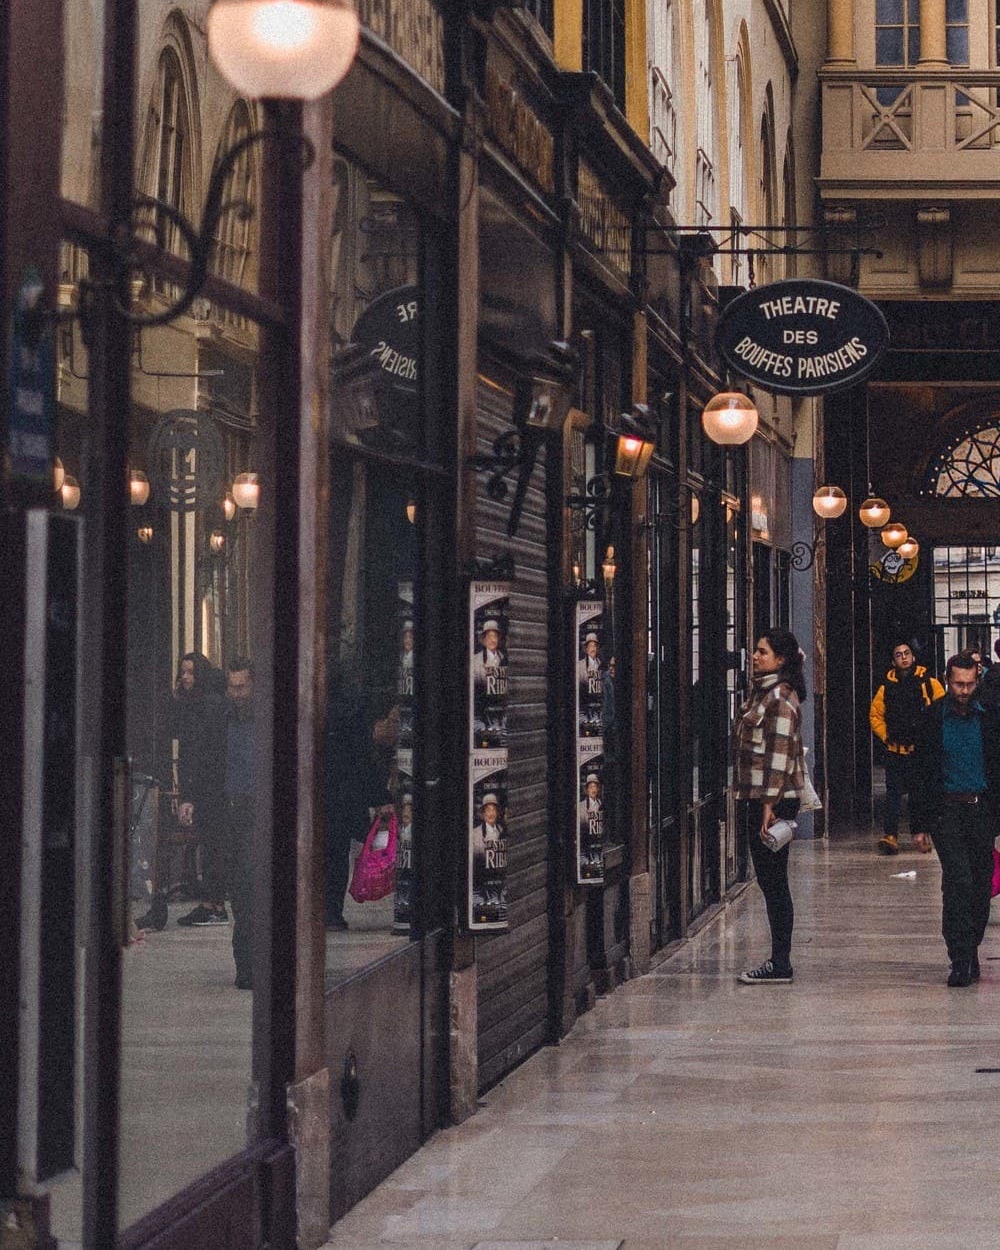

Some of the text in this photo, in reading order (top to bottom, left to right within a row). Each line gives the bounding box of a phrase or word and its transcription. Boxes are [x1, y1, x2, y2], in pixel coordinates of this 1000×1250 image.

[759, 296, 840, 320] THEATRE
[783, 330, 818, 344] DES
[734, 336, 868, 378] BOUFFES PARISIENS
